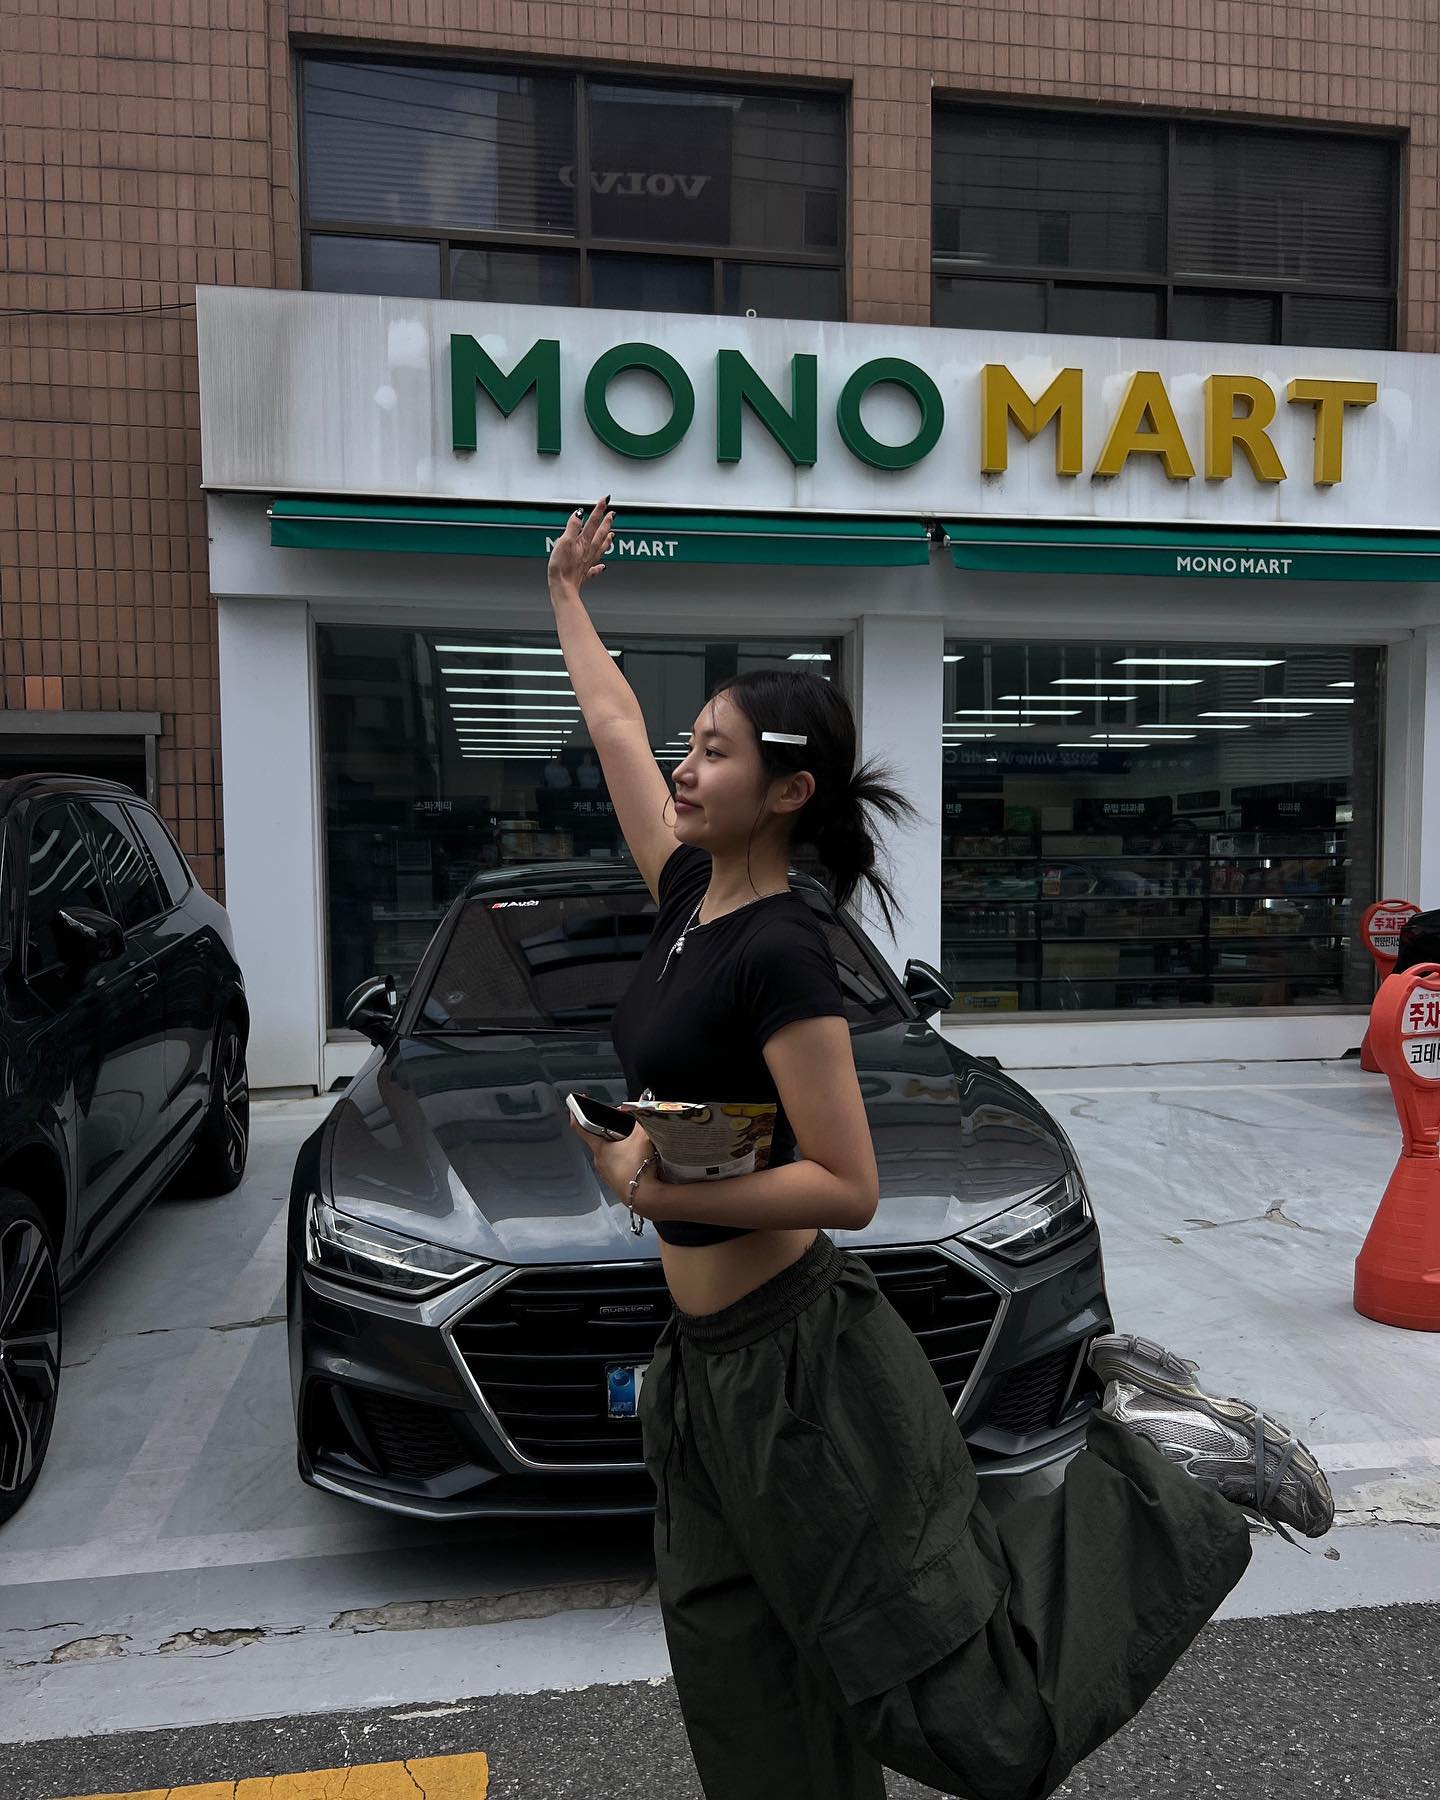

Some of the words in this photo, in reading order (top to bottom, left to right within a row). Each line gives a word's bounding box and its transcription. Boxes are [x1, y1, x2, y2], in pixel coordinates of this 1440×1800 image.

[450, 333, 945, 471] MONO
[981, 364, 1378, 486] MART
[618, 539, 679, 557] MART
[1176, 556, 1237, 573] MONO
[1240, 558, 1293, 574] MART
[412, 800, 452, 813] 스파게티
[1374, 917, 1408, 930] 주차금
